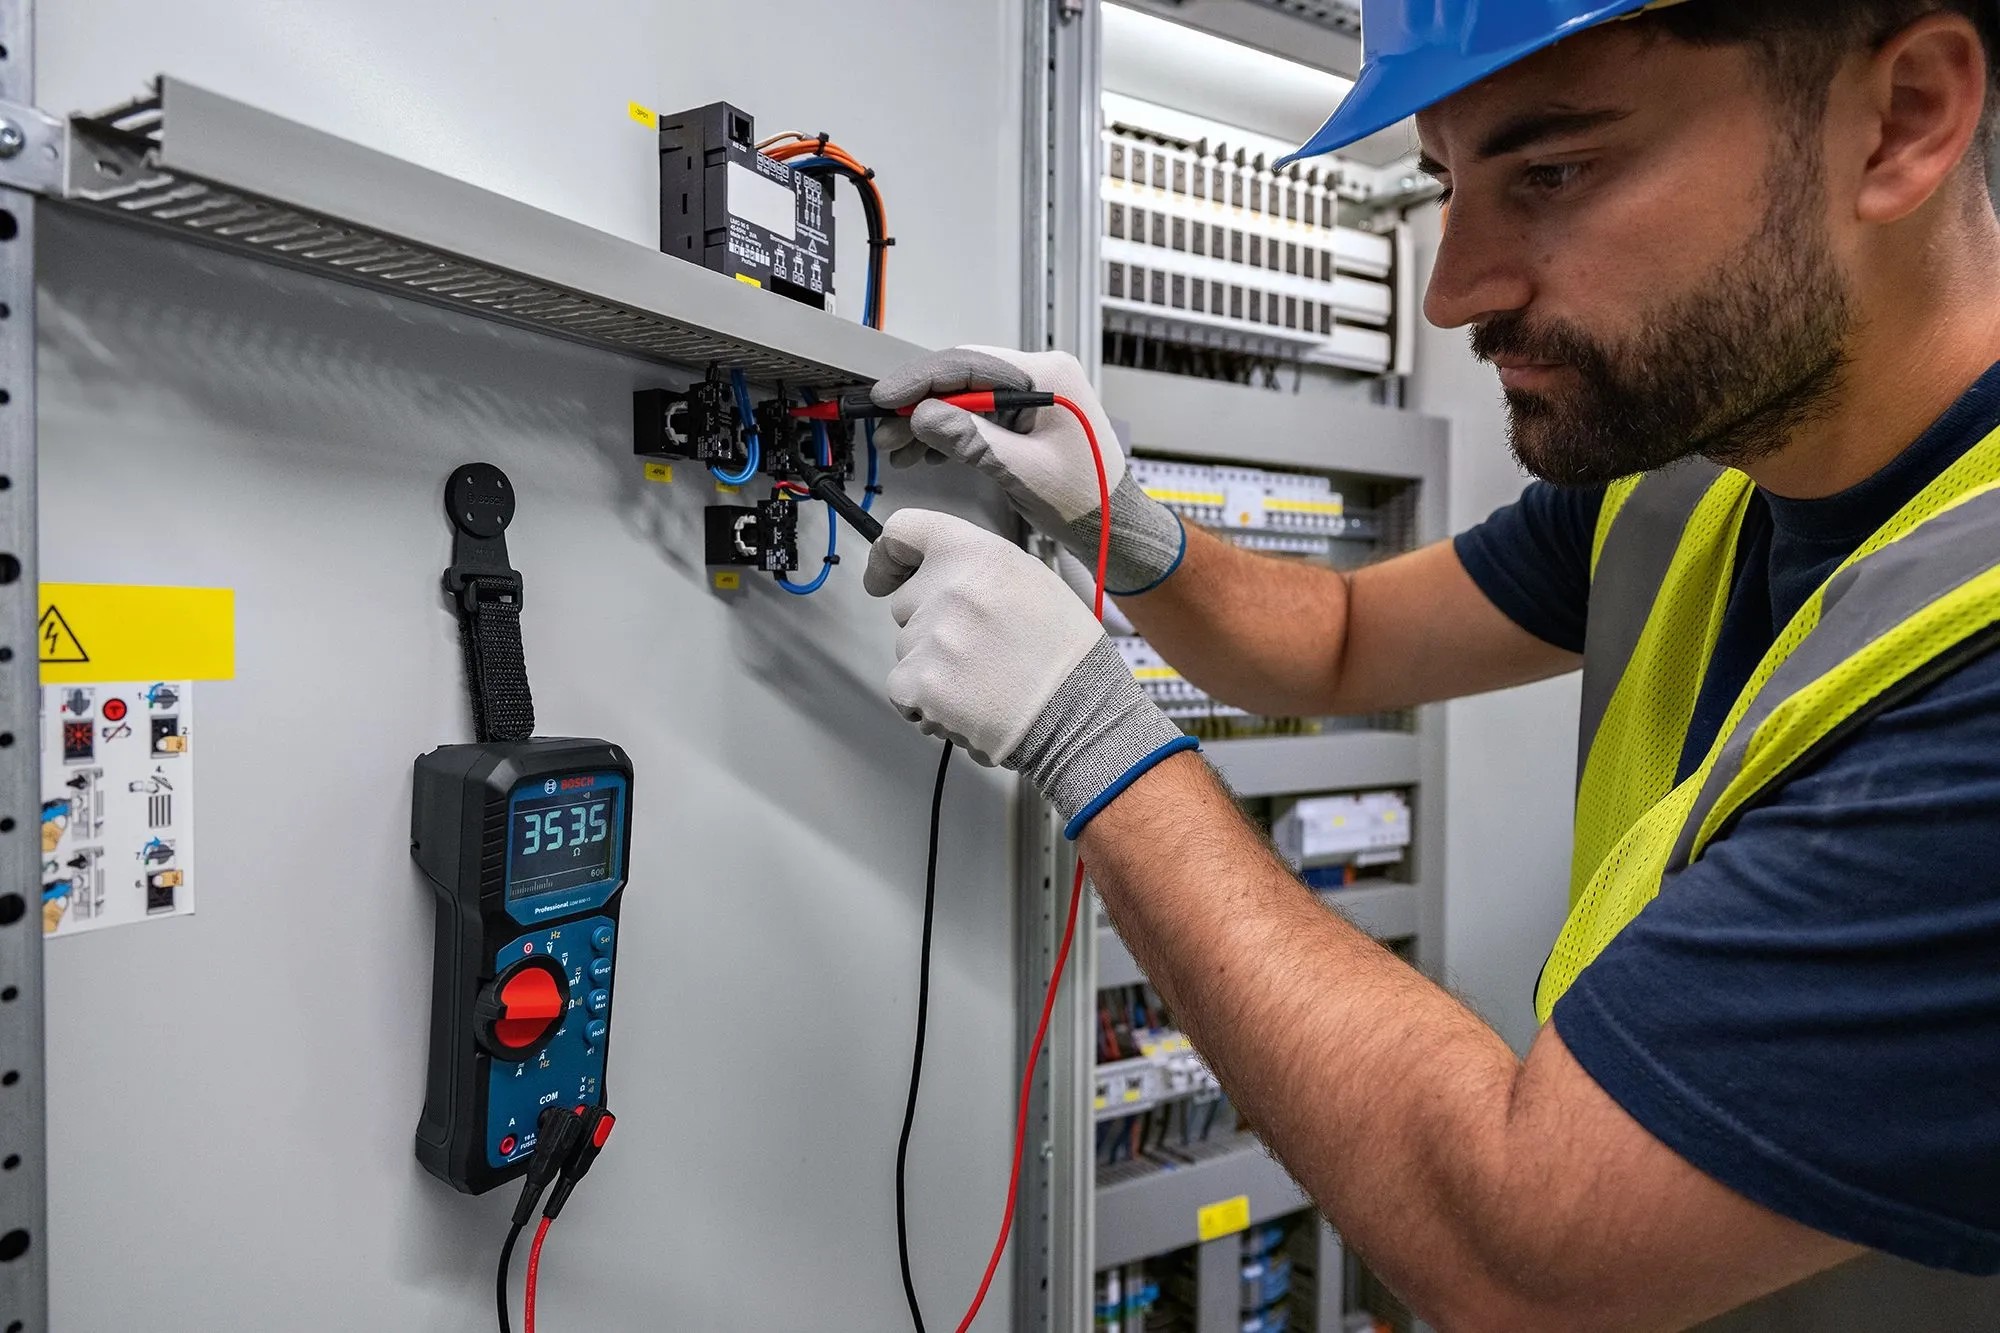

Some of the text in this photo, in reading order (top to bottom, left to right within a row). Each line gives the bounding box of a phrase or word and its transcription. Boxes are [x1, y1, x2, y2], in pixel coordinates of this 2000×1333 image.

[561, 776, 594, 791] BOSCH
[522, 803, 607, 856] 353.5
[534, 900, 569, 914] Professional
[550, 931, 561, 940] Hz
[594, 966, 611, 975] Range
[592, 1027, 605, 1038] Hold
[539, 1091, 559, 1105] COM
[508, 1117, 516, 1127] A
